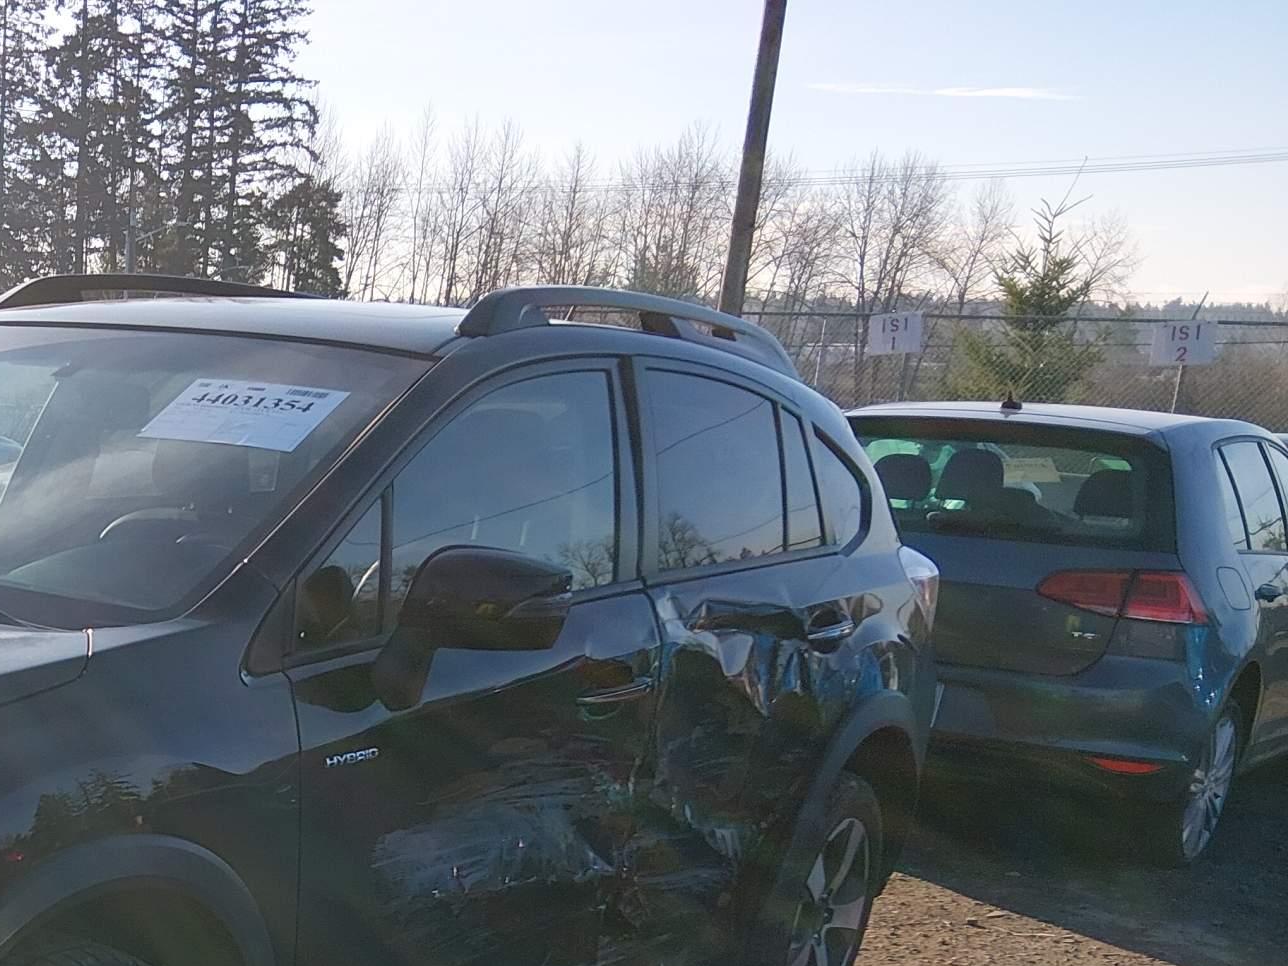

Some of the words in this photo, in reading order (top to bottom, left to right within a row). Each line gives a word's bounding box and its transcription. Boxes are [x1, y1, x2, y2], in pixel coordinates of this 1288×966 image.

[1175, 346, 1187, 362] 2
[192, 391, 315, 413] 44031354
[325, 747, 379, 768] HYBRID
